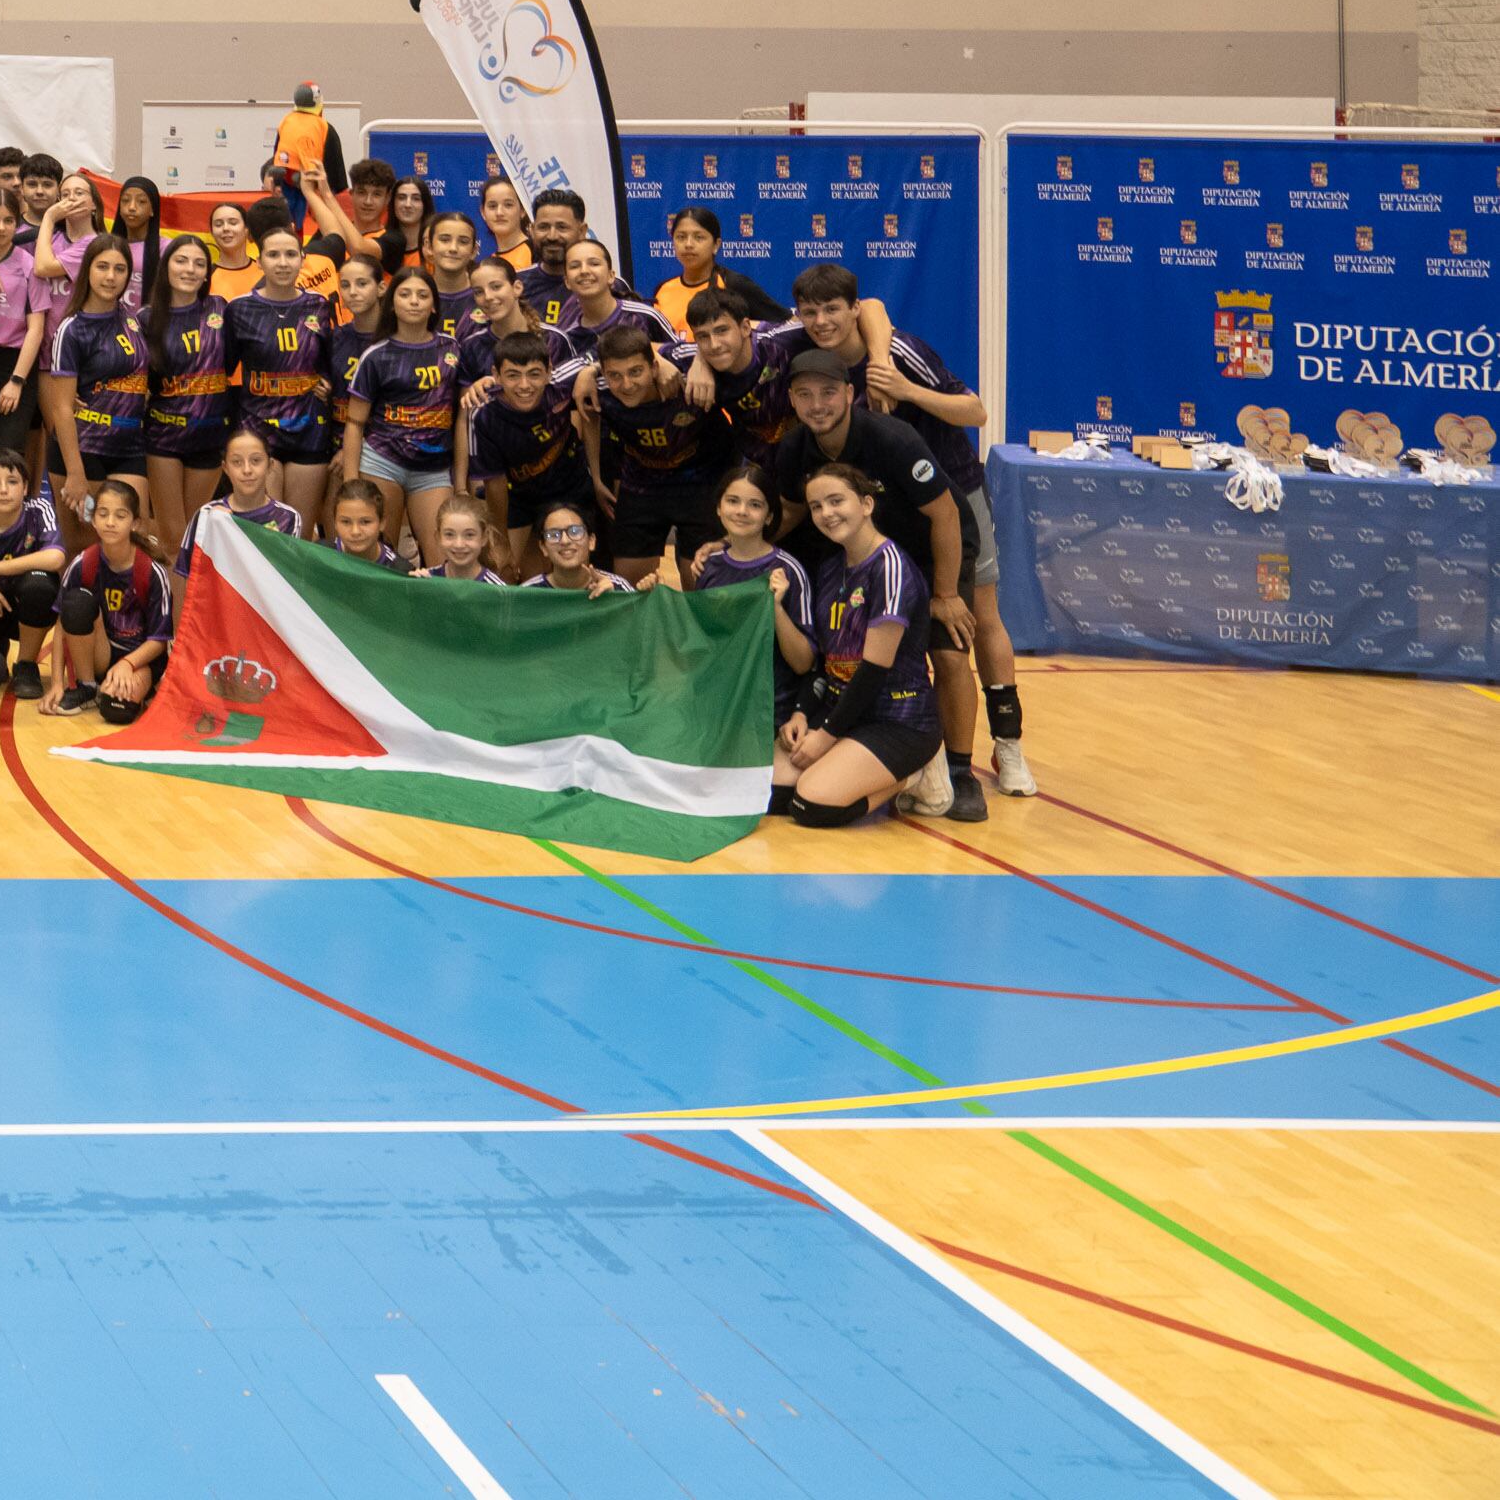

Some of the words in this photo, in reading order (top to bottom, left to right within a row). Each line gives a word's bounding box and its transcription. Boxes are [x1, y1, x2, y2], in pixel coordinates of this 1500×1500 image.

[686, 182, 735, 191] DIPUTACIÓN
[687, 190, 697, 199] DE
[699, 190, 734, 199] ALMERÍA
[903, 182, 952, 191] DIPUTACIÓN
[903, 190, 914, 199] DE
[916, 190, 951, 199] ALMERÍA
[1037, 183, 1092, 193] DIPUTACIÓN
[1038, 192, 1050, 200] DE
[1052, 192, 1091, 202] ALMERÍA
[1379, 193, 1442, 203] DIPUTACIÓN
[1380, 202, 1394, 211] DE
[1396, 202, 1441, 213] ALMERÍA
[1160, 247, 1217, 258] DIPUTACIÓN
[1161, 256, 1173, 265] DE
[1175, 257, 1216, 267] ALMERÍA
[546, 301, 560, 324] 9
[115, 334, 135, 356] 9
[181, 330, 200, 354] 17
[276, 327, 298, 352] 10
[1294, 323, 1500, 357] DIPUTACIÓ
[415, 366, 441, 390] 20
[1298, 355, 1344, 382] DE
[1354, 359, 1500, 392] ALMERÍ
[637, 428, 667, 447] 36
[104, 588, 125, 612] 19
[1216, 607, 1334, 629] DIPUTACIÓN
[1218, 624, 1244, 642] DE
[1251, 625, 1331, 646] ALMERÍA
